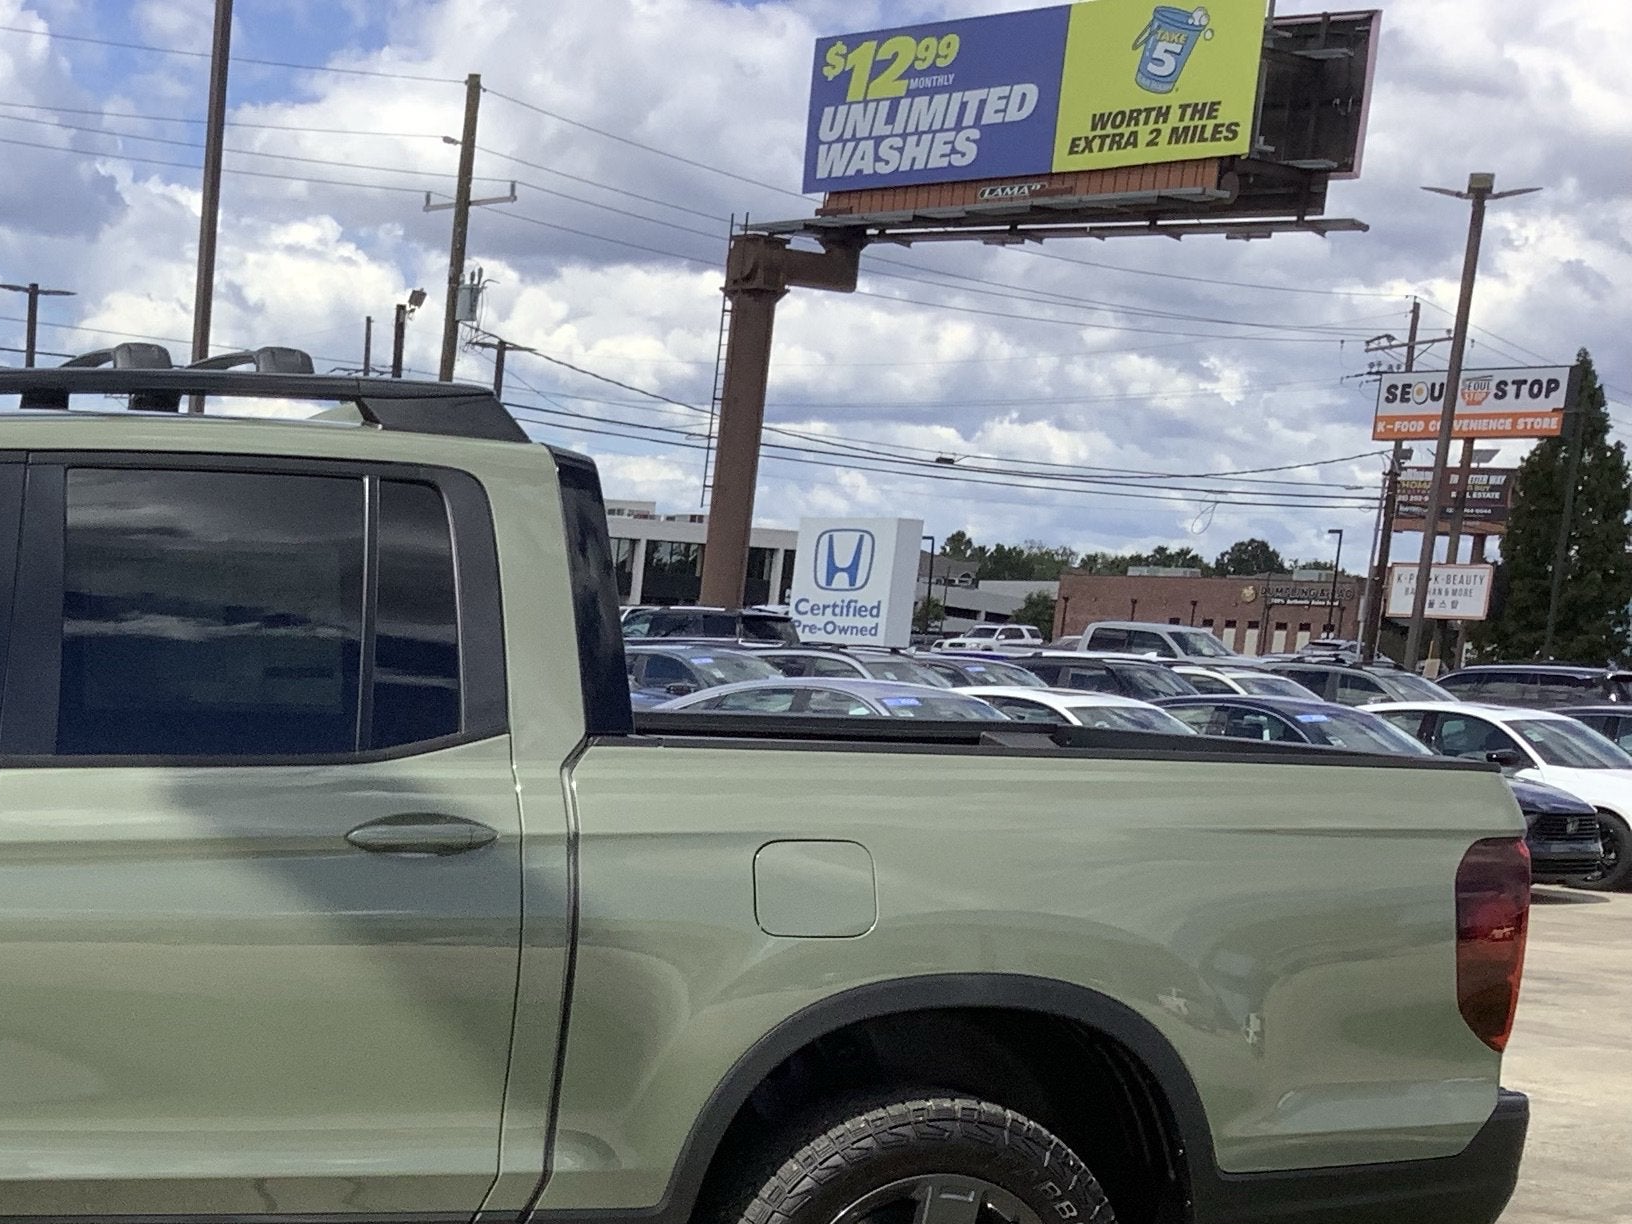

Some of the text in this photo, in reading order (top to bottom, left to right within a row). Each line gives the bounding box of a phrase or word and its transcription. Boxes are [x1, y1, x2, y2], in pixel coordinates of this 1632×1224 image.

[1155, 29, 1189, 44] TAKE
[1146, 41, 1184, 78] 5
[909, 73, 956, 90] MONTHLY
[818, 83, 1040, 142] UNLIMITED
[1090, 101, 1222, 132] WORTH THE
[1067, 122, 1241, 156] EXTRA 2 MILES
[815, 128, 981, 180] WASHES
[1384, 378, 1560, 405] SEOU STOP
[1376, 416, 1559, 433] K-FOOD CVENIENCE STORE
[794, 597, 882, 619] Certified
[792, 620, 880, 637] Pre-Owned
